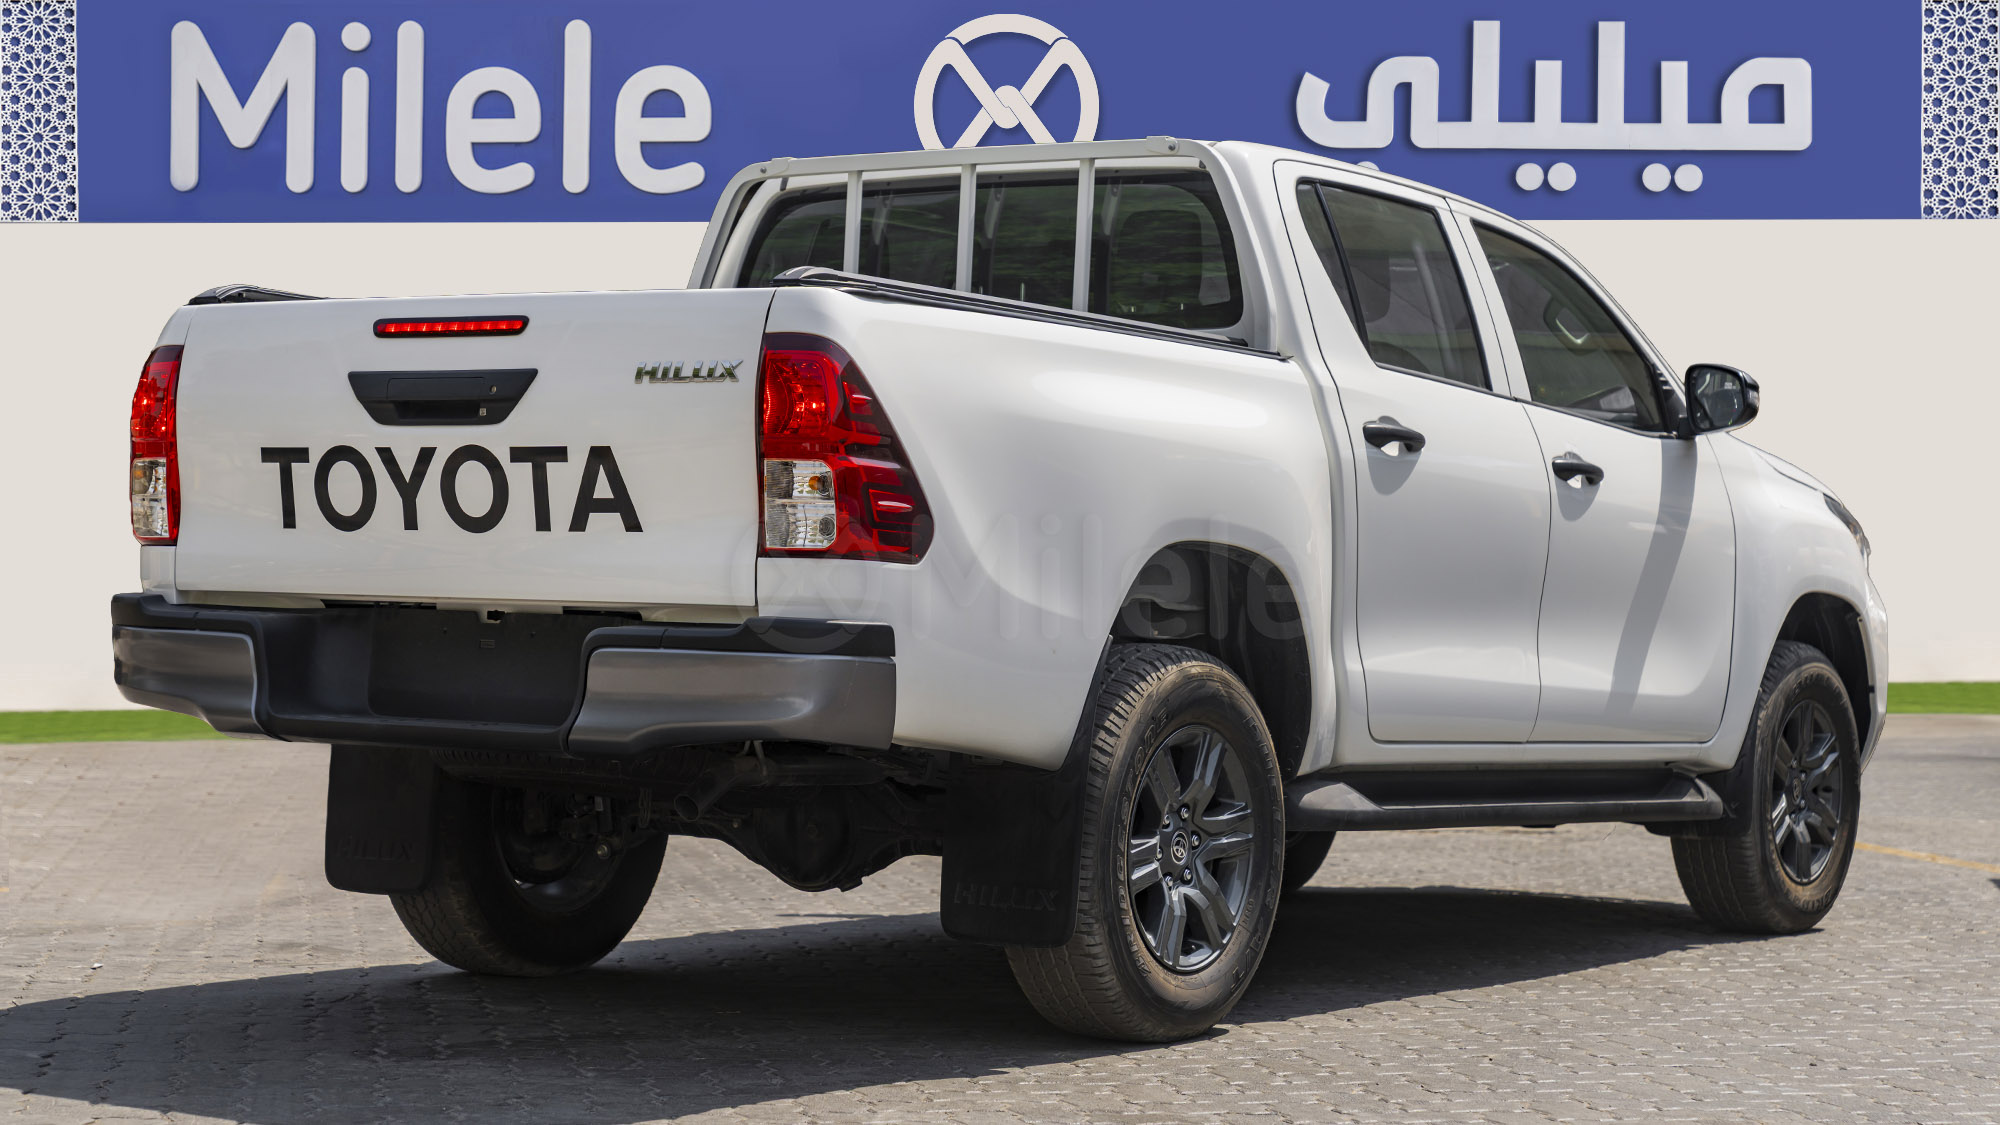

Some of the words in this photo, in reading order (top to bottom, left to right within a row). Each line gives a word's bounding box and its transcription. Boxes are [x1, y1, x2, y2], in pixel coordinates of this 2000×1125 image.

[170, 19, 712, 194] Milele
[634, 359, 744, 384] HILUX
[260, 444, 644, 534] TOYOTA
[953, 881, 1060, 912] HILUX
